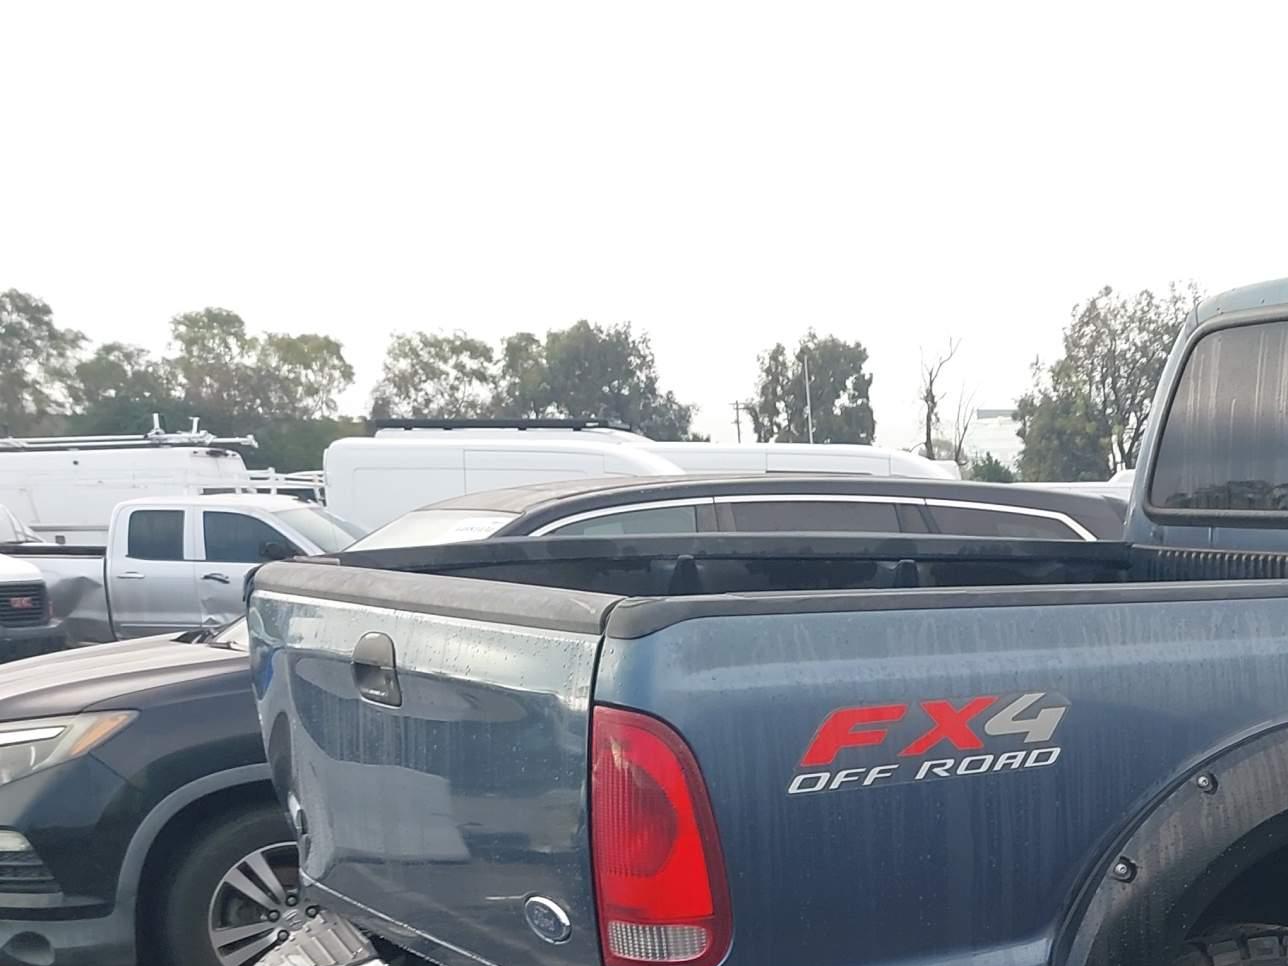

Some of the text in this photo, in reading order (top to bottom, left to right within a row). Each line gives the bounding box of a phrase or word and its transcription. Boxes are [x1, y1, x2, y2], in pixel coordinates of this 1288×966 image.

[799, 692, 1068, 768] FX4
[787, 747, 1062, 795] OFF ROAD
